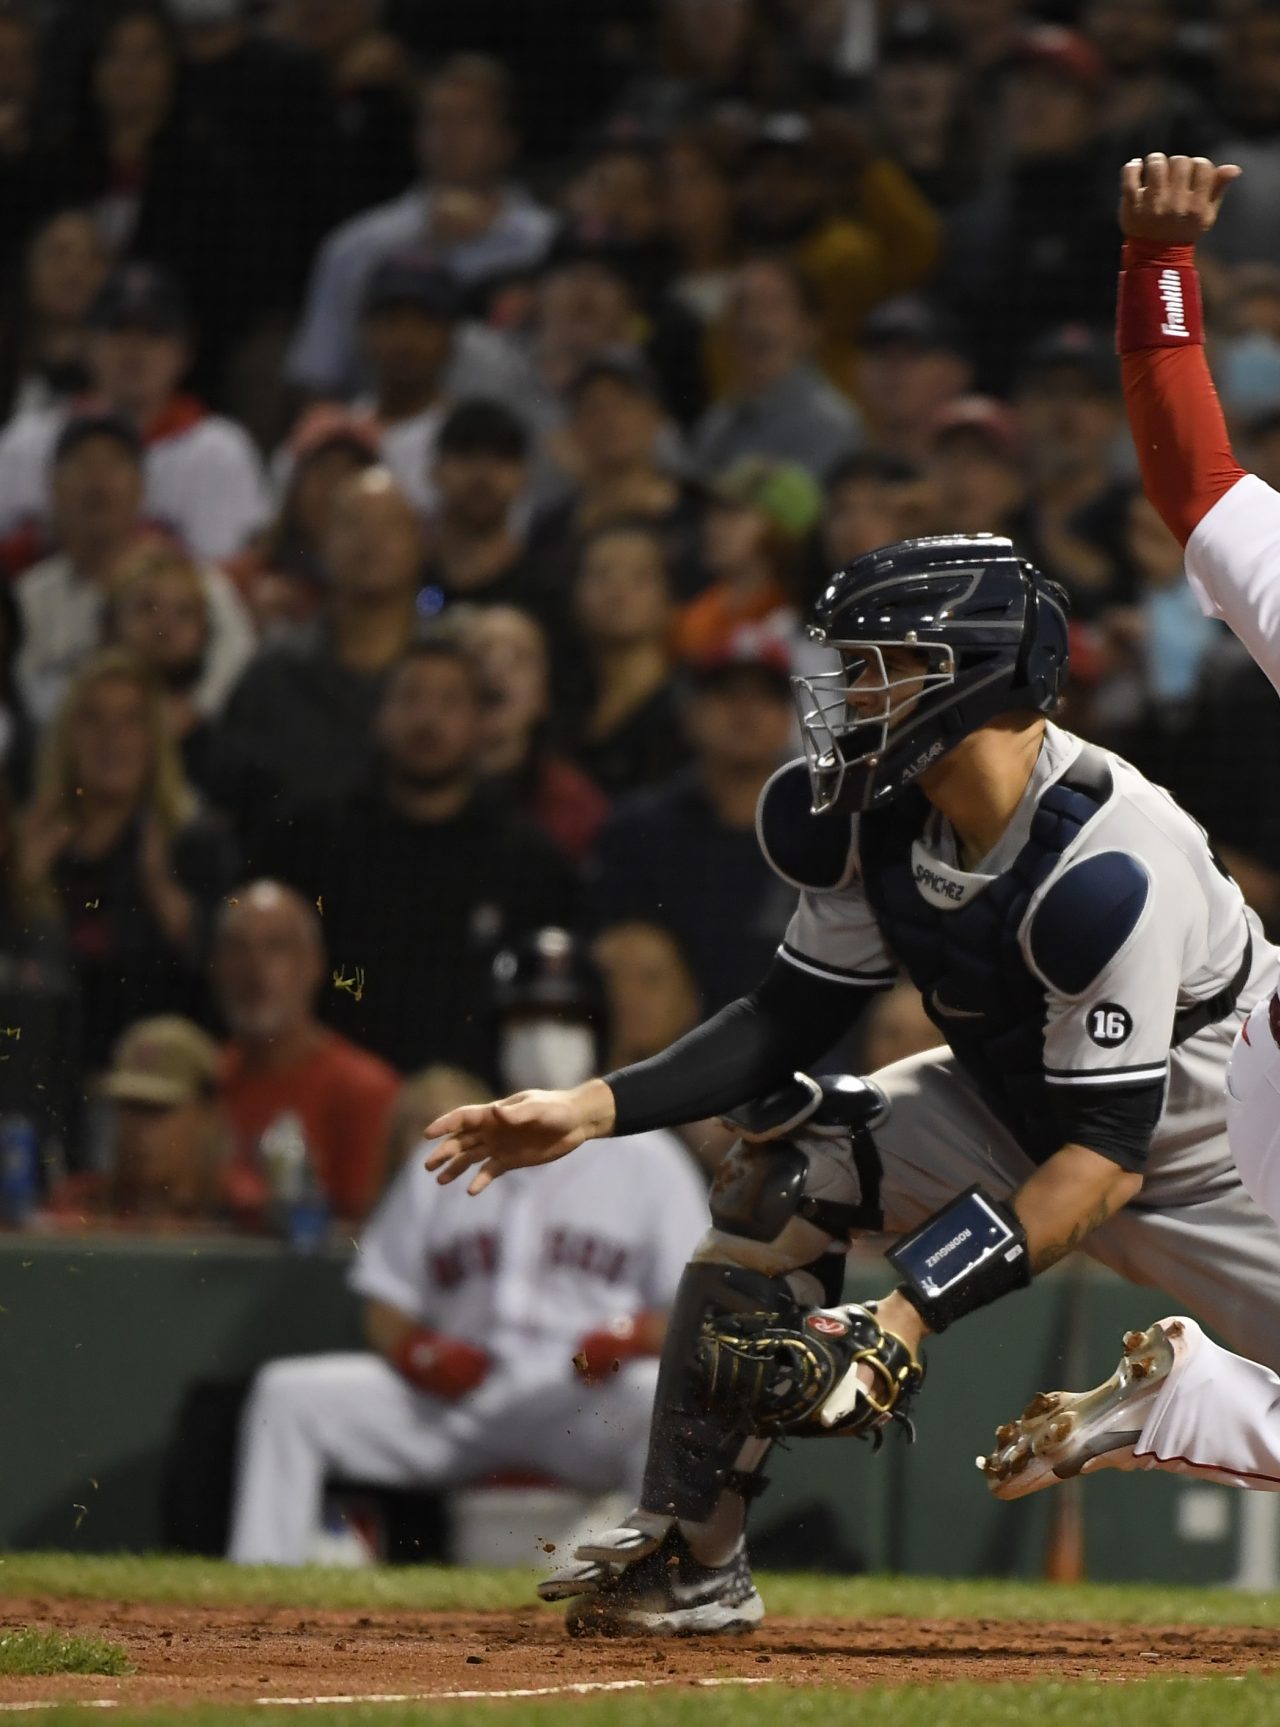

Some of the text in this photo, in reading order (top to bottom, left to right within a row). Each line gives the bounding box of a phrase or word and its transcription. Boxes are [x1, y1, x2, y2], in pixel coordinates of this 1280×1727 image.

[1158, 269, 1190, 337] Franklin
[1093, 1010, 1125, 1039] 16
[924, 1228, 973, 1268] RODRIGUEZ
